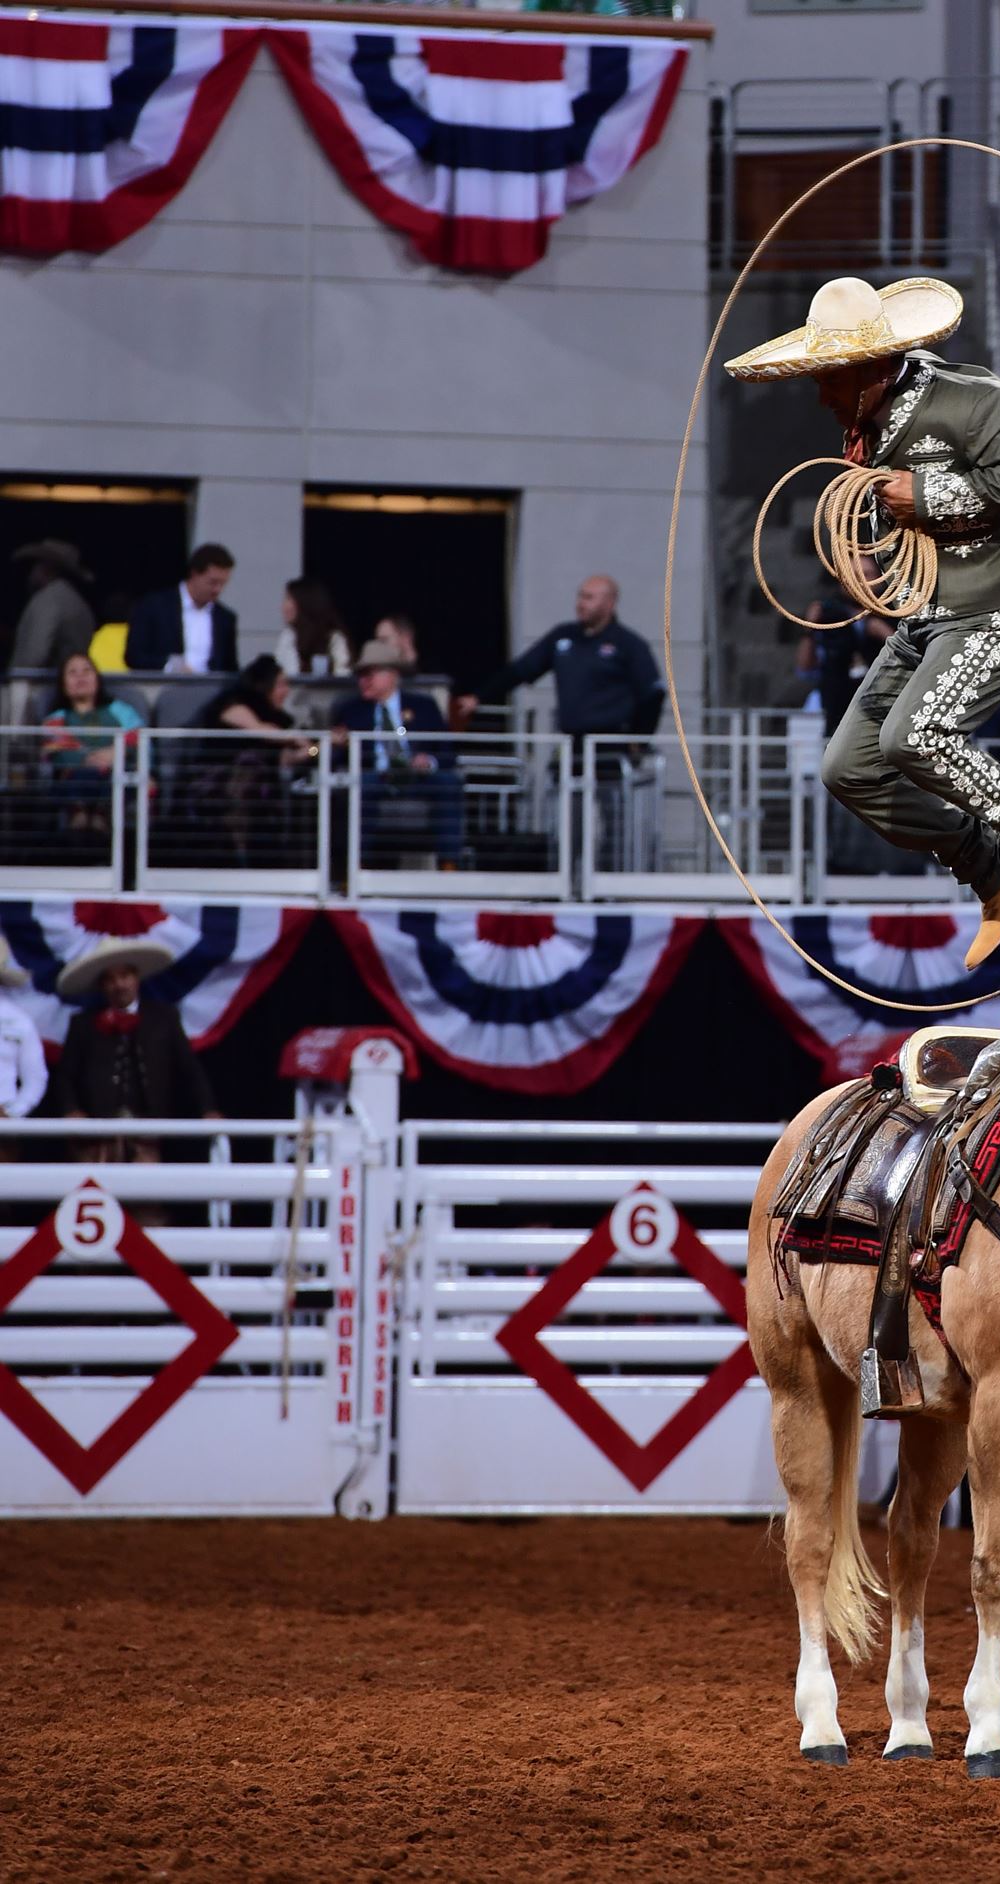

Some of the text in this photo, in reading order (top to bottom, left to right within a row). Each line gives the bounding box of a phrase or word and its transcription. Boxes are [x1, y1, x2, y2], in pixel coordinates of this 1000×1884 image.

[73, 1201, 106, 1245] 5
[630, 1204, 658, 1246] 6
[337, 1167, 355, 1424] FORT WORTH
